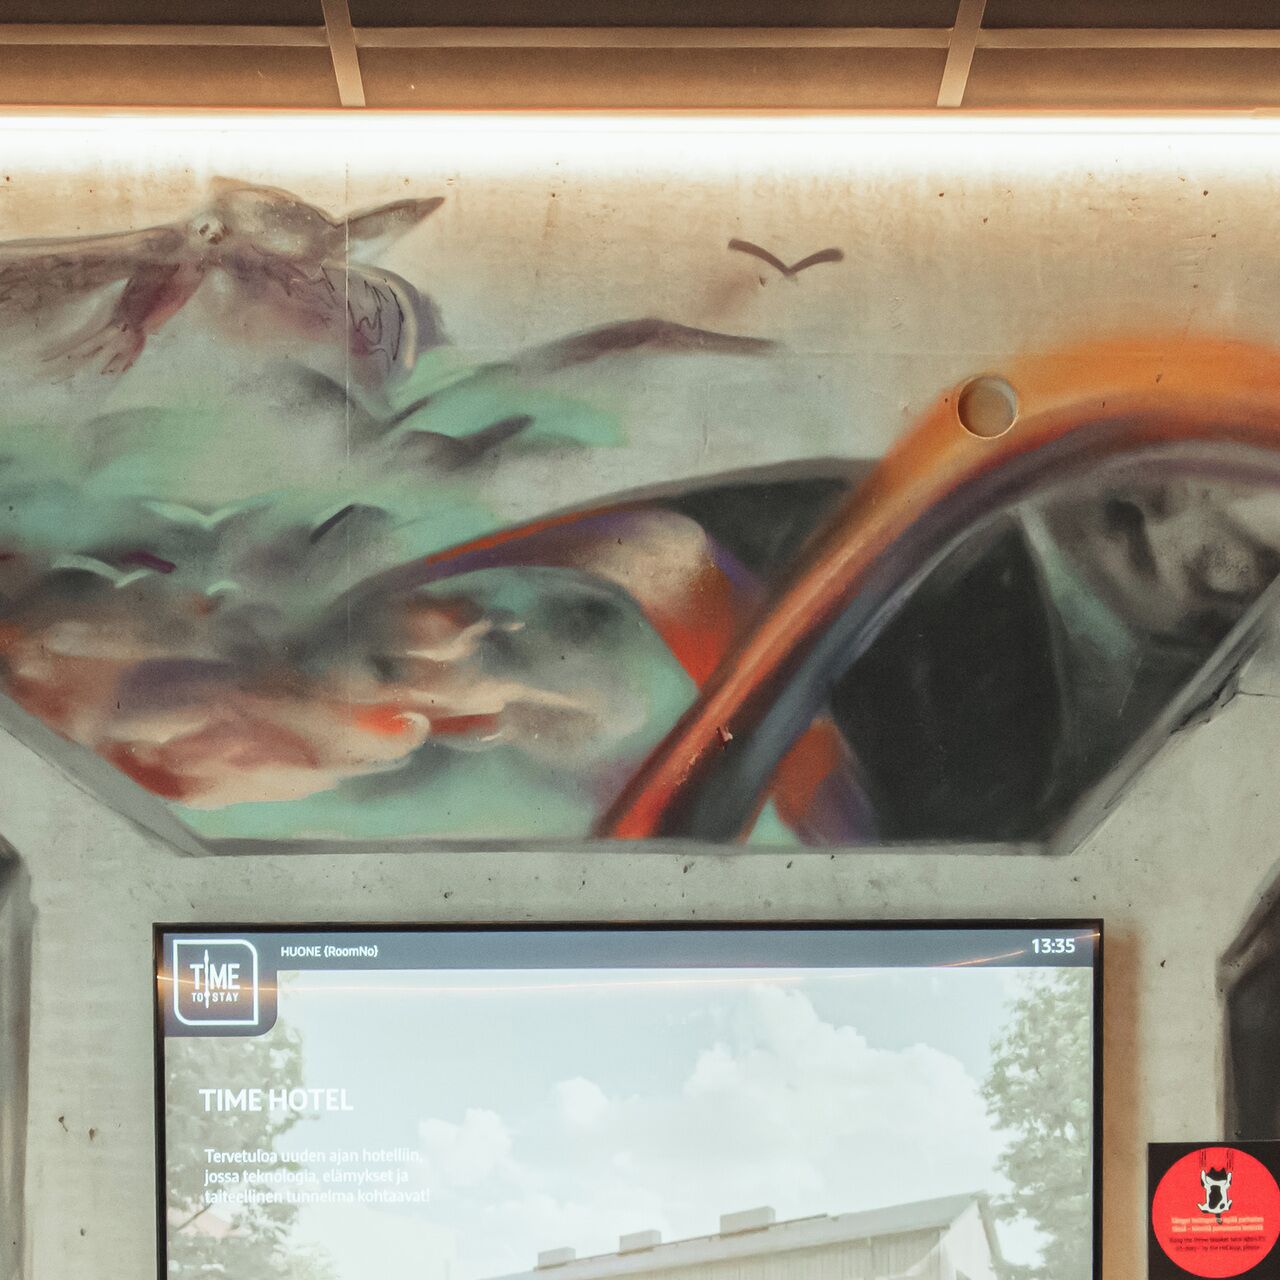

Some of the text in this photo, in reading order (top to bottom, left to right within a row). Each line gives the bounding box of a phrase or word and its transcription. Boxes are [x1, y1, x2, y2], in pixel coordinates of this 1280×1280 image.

[280, 944, 379, 958] HUONE {RoomNo}
[1031, 937, 1076, 954] 13:35
[189, 956, 241, 991] TIME
[191, 991, 239, 1003] TO STAY
[198, 1087, 354, 1112] TIME HOTEL
[204, 1148, 278, 1163] Tervetuloa
[281, 1149, 326, 1163] uuden
[329, 1149, 359, 1165] ajan
[204, 1168, 409, 1186] jossa teknologia, elämykset ja
[204, 1189, 283, 1204] taiteellinen
[286, 1189, 357, 1203] tunnelma
